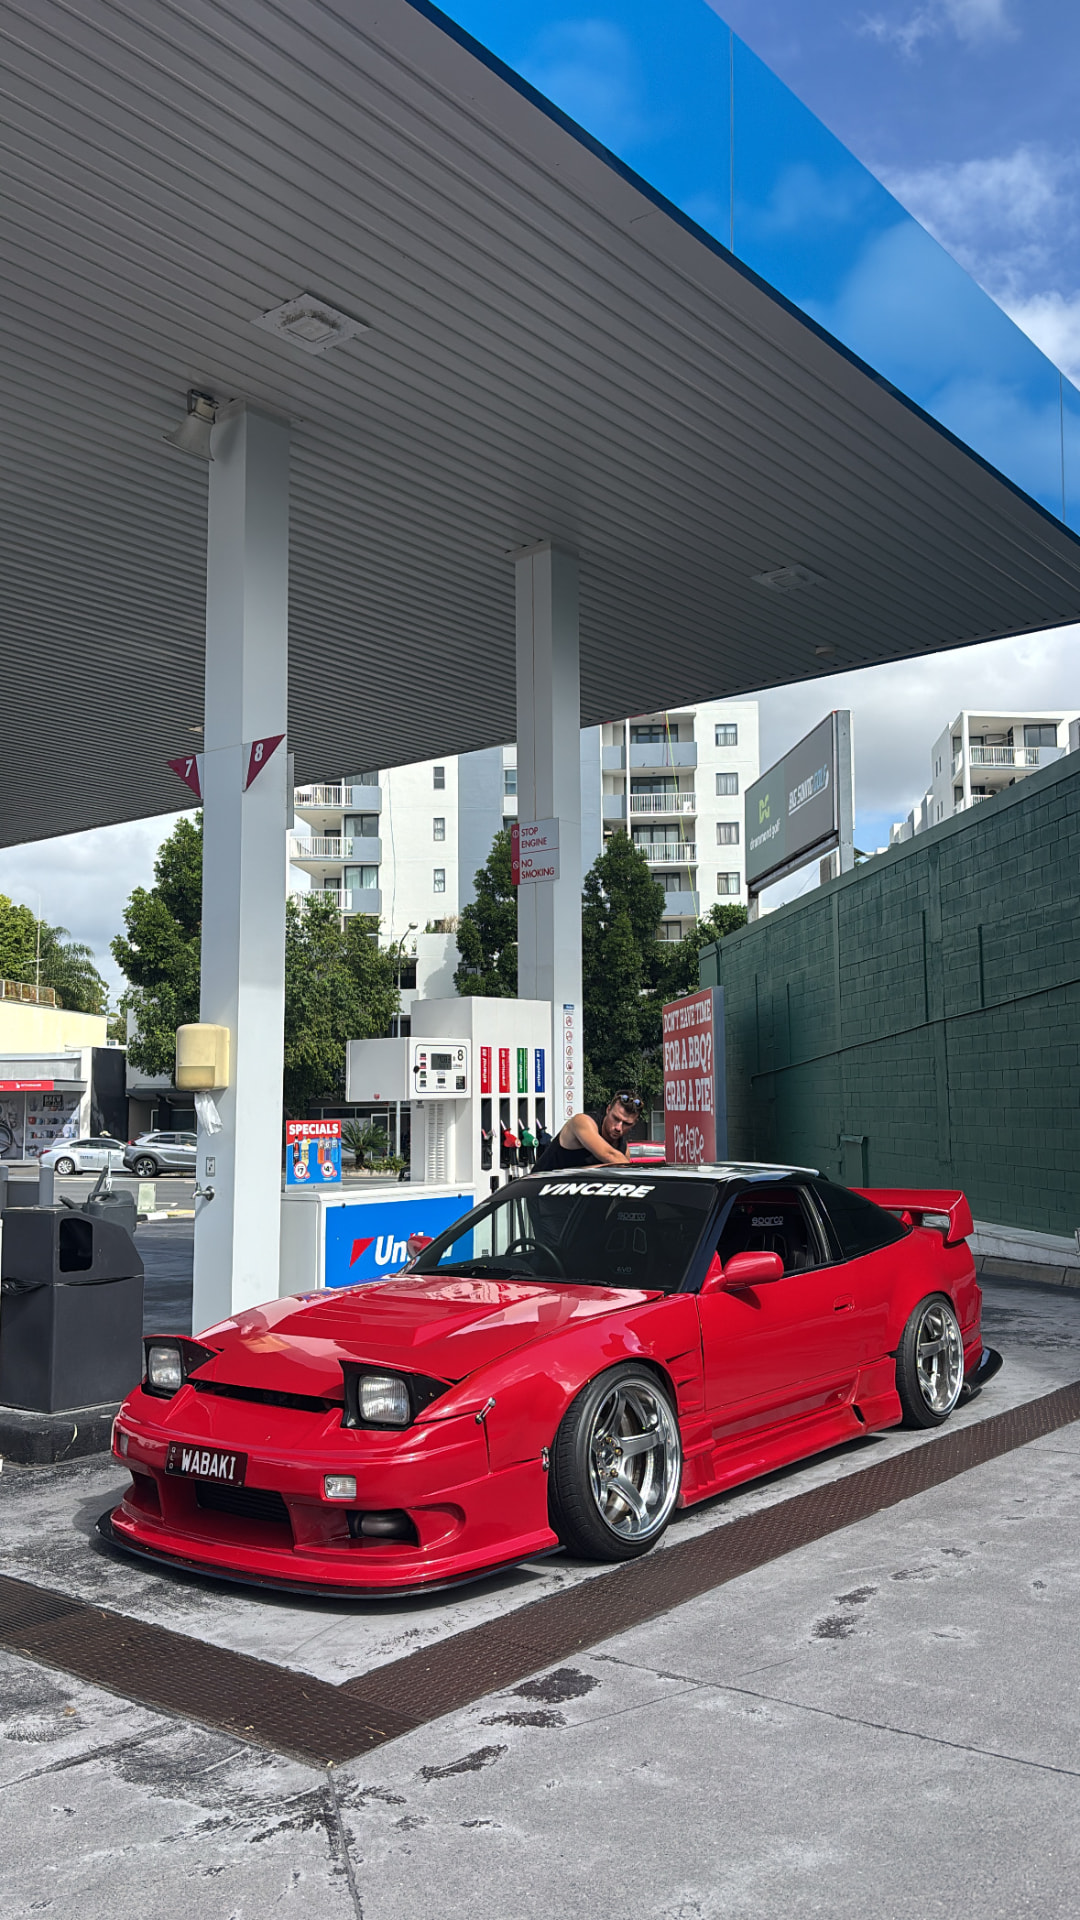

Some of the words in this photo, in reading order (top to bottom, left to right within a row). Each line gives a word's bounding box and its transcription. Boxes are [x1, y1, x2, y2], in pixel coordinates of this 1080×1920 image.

[254, 742, 264, 762] 8
[185, 759, 194, 778] 7
[521, 827, 538, 836] STOP
[521, 837, 547, 848] ENGINE
[521, 859, 532, 868] NO
[521, 867, 554, 879] SMOKING
[680, 1004, 695, 1029] HAVE
[695, 998, 712, 1025] TIME
[457, 1049, 464, 1061] 8
[664, 1039, 681, 1072] FOR
[681, 1038, 688, 1070] A
[688, 1031, 712, 1074] BBQ?
[665, 1080, 687, 1111] GRAB
[687, 1079, 695, 1111] A
[695, 1075, 714, 1116] PIE!
[289, 1123, 338, 1135] SPECIALS
[539, 1182, 656, 1198] VINCERE
[181, 1449, 236, 1480] WABAKI
